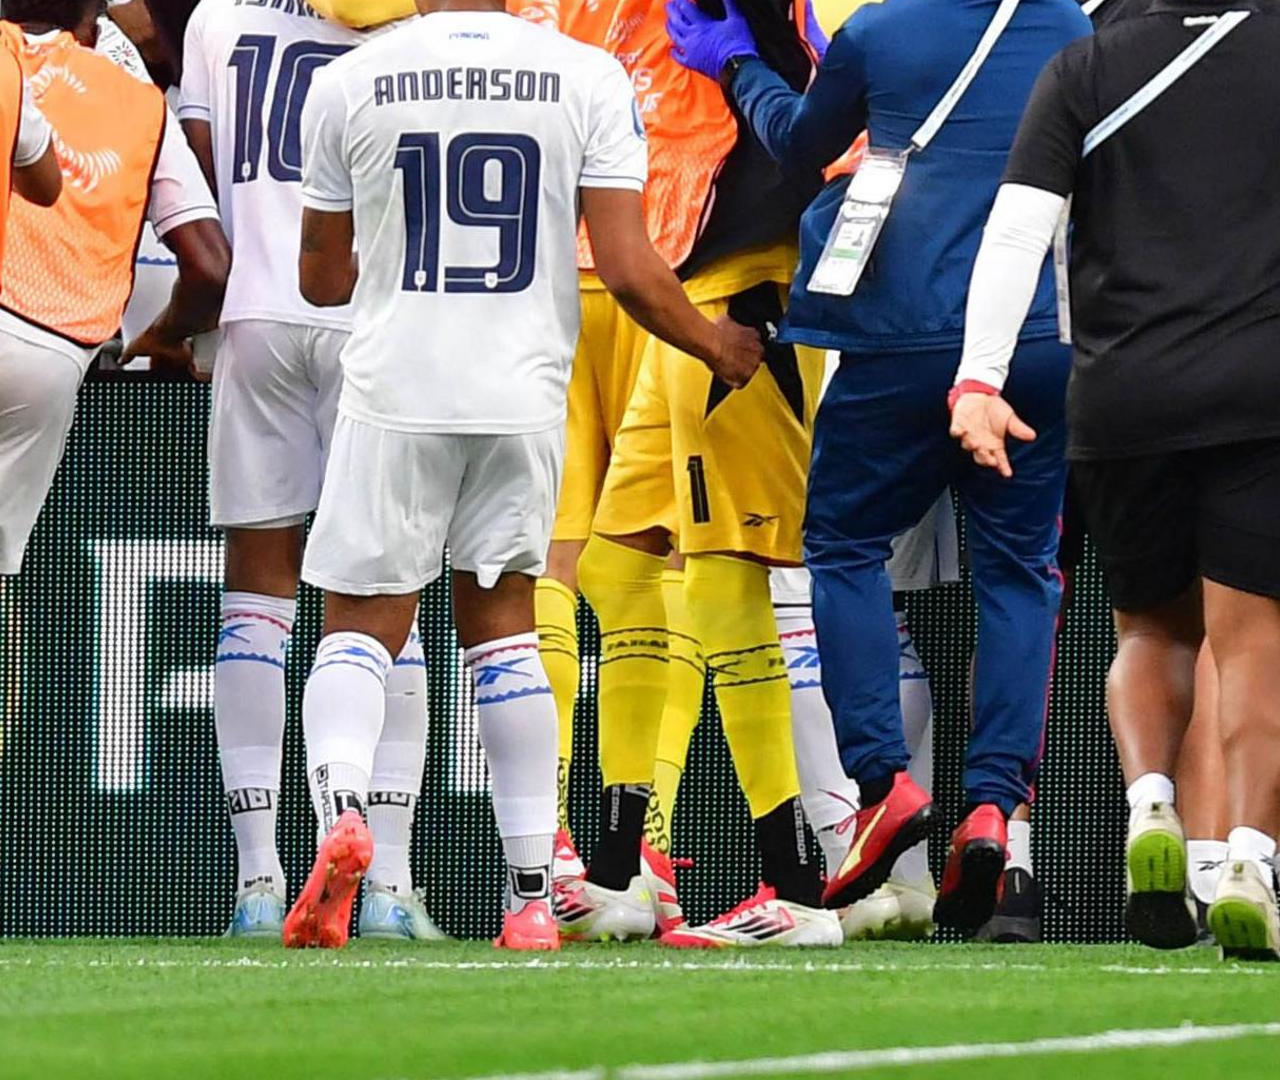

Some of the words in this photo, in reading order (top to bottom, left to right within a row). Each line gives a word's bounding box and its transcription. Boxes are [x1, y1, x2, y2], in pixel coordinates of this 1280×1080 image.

[373, 66, 562, 107] ANDERSON
[392, 131, 542, 294] 19
[687, 455, 710, 524] 1
